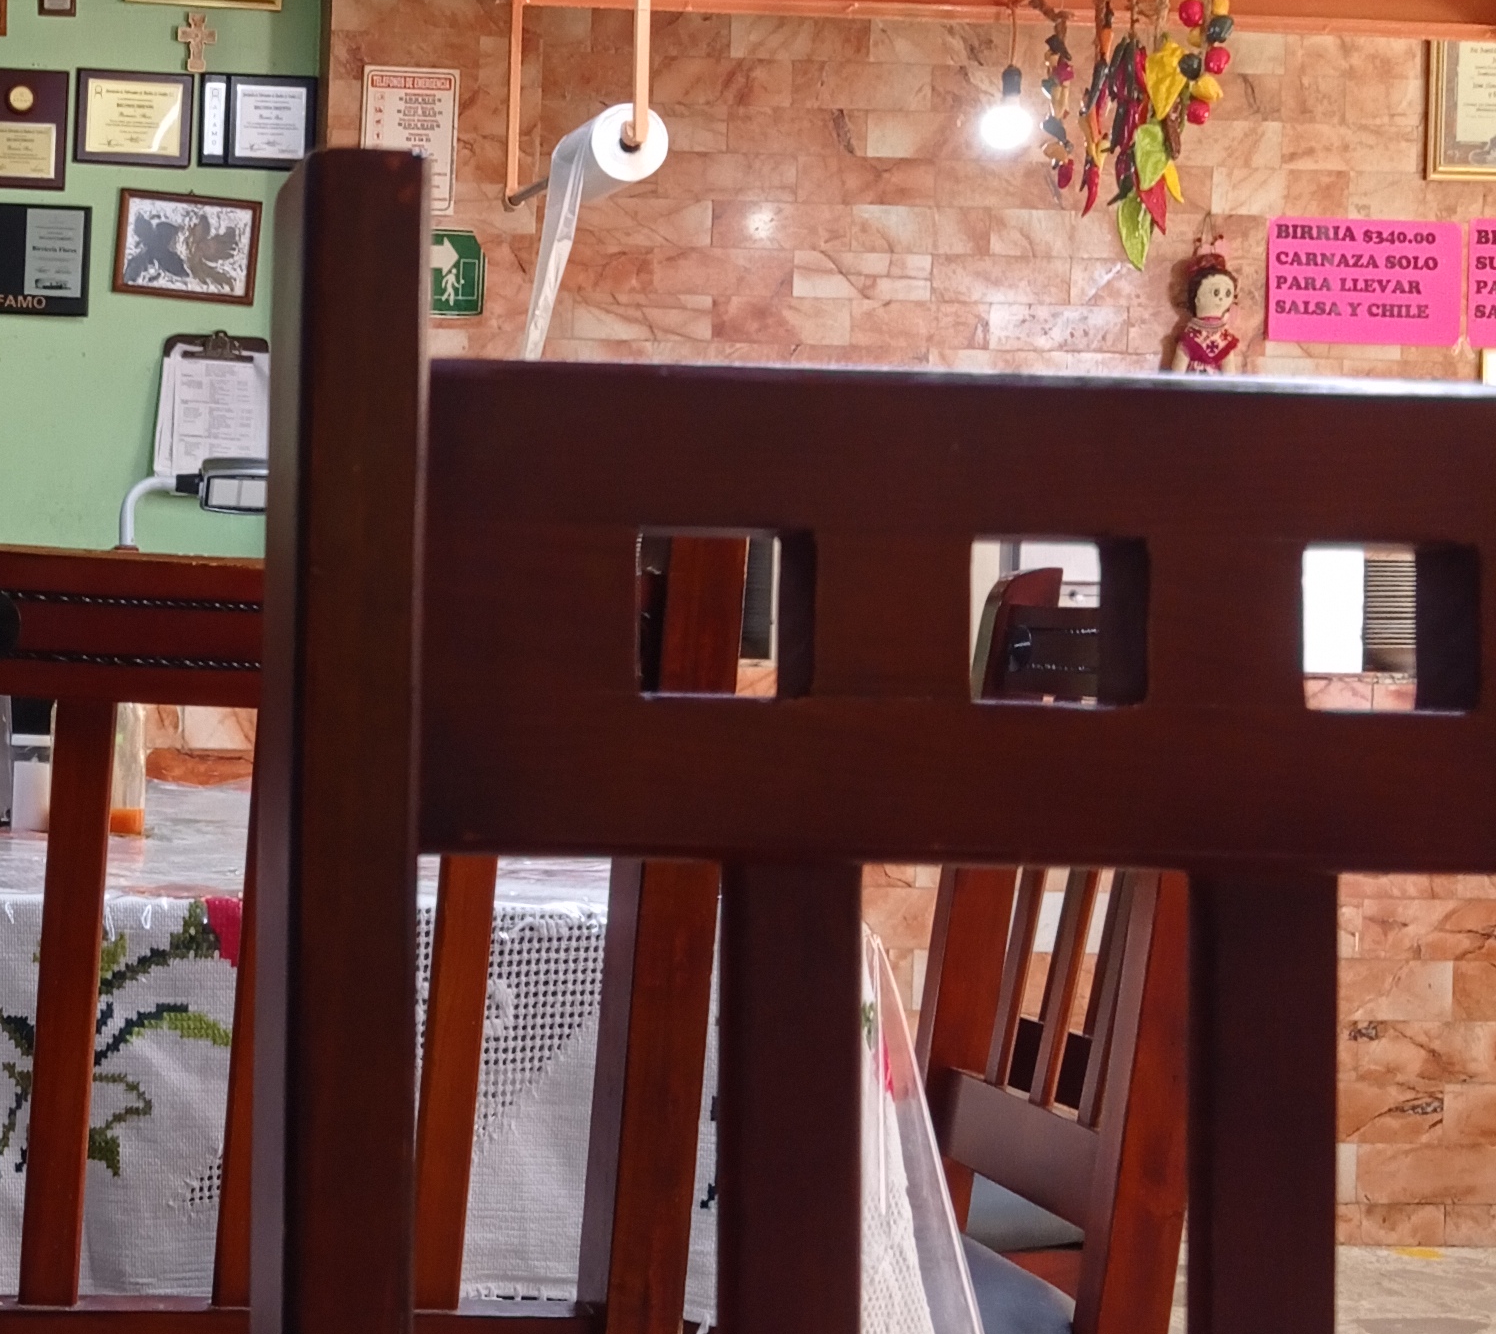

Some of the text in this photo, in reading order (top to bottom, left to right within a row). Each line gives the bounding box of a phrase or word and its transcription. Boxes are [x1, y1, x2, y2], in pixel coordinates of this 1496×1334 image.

[1275, 223, 1436, 245] BIRRIA $340.00
[1275, 251, 1439, 271] CARNAZA SOLO
[1275, 275, 1421, 295] PARA LLEVAR
[1275, 299, 1429, 319] SALSA Y CHILE
